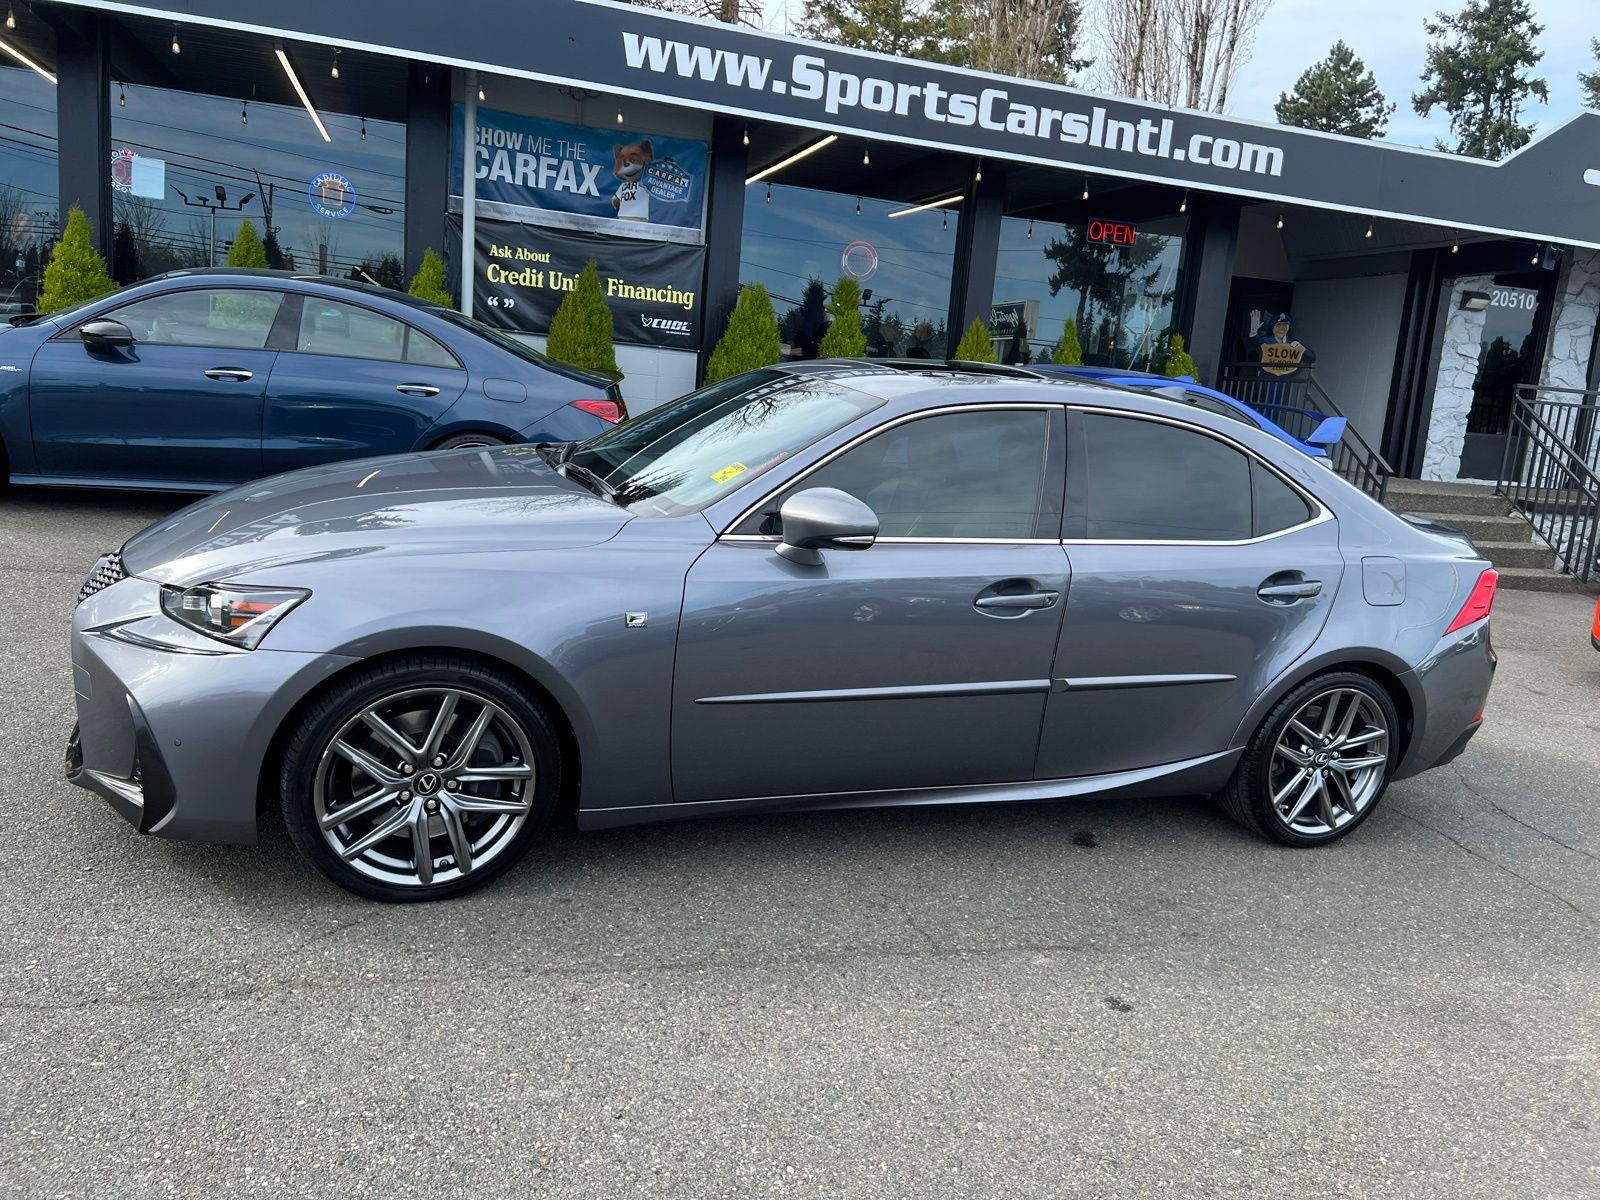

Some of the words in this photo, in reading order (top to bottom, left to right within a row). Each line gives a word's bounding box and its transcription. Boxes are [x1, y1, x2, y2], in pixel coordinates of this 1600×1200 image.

[622, 31, 1284, 177] www.SportsCarsIntl.com
[527, 135, 552, 156] ME
[557, 139, 587, 161] THE
[475, 144, 601, 197] CARFAX
[647, 166, 689, 188] CARFAX
[313, 173, 353, 193] CADILLAC
[621, 180, 640, 192] CAR
[648, 177, 684, 195] ADVANTAGE
[651, 186, 676, 200] DEALER
[620, 191, 636, 202] FOX
[315, 203, 349, 217] SERVICE
[1089, 221, 1136, 246] OPEN
[489, 244, 513, 260] Ask
[514, 247, 551, 264] About
[486, 263, 544, 289] Credit
[606, 277, 695, 311] Financing
[1490, 290, 1535, 310] 20510
[1267, 347, 1300, 360] SLOW
